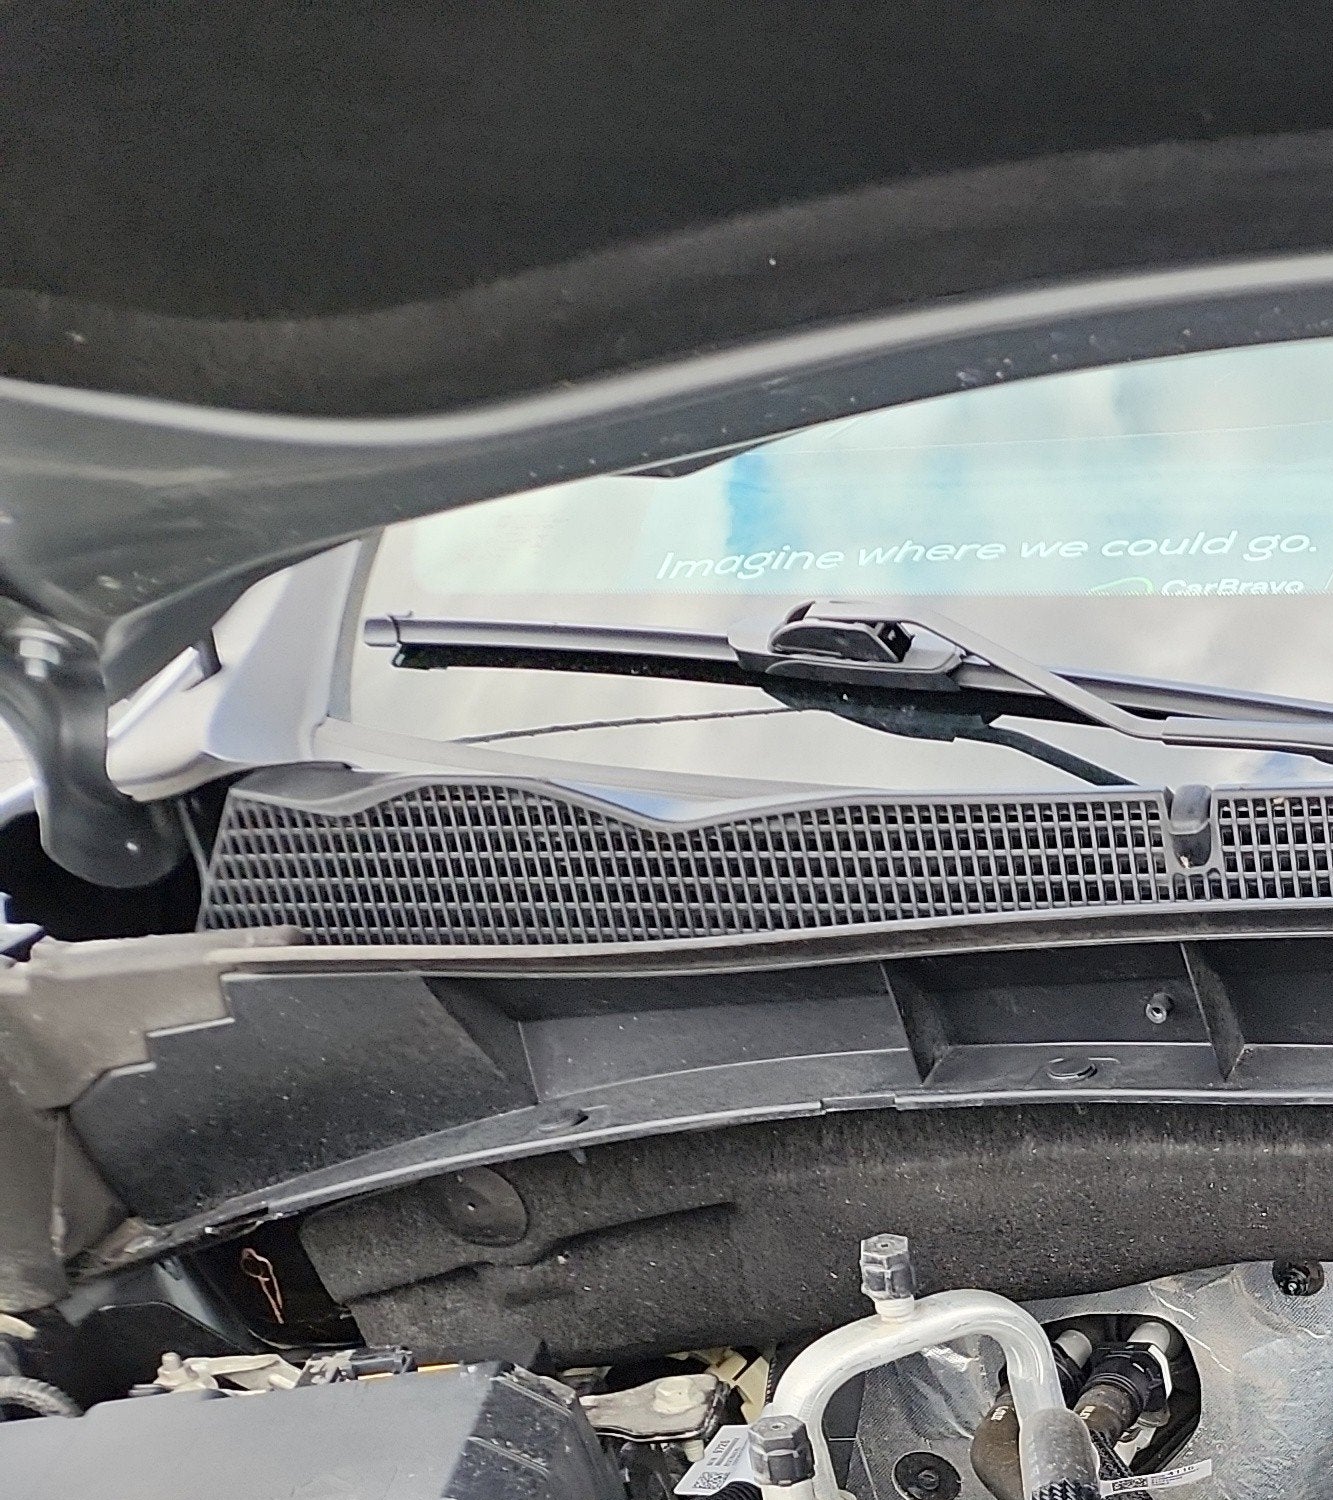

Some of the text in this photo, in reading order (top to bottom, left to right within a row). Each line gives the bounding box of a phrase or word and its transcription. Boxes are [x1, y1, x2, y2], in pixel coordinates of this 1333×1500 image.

[656, 530, 1317, 580] Imagine where we could go.
[1162, 578, 1304, 595] CarBravo
